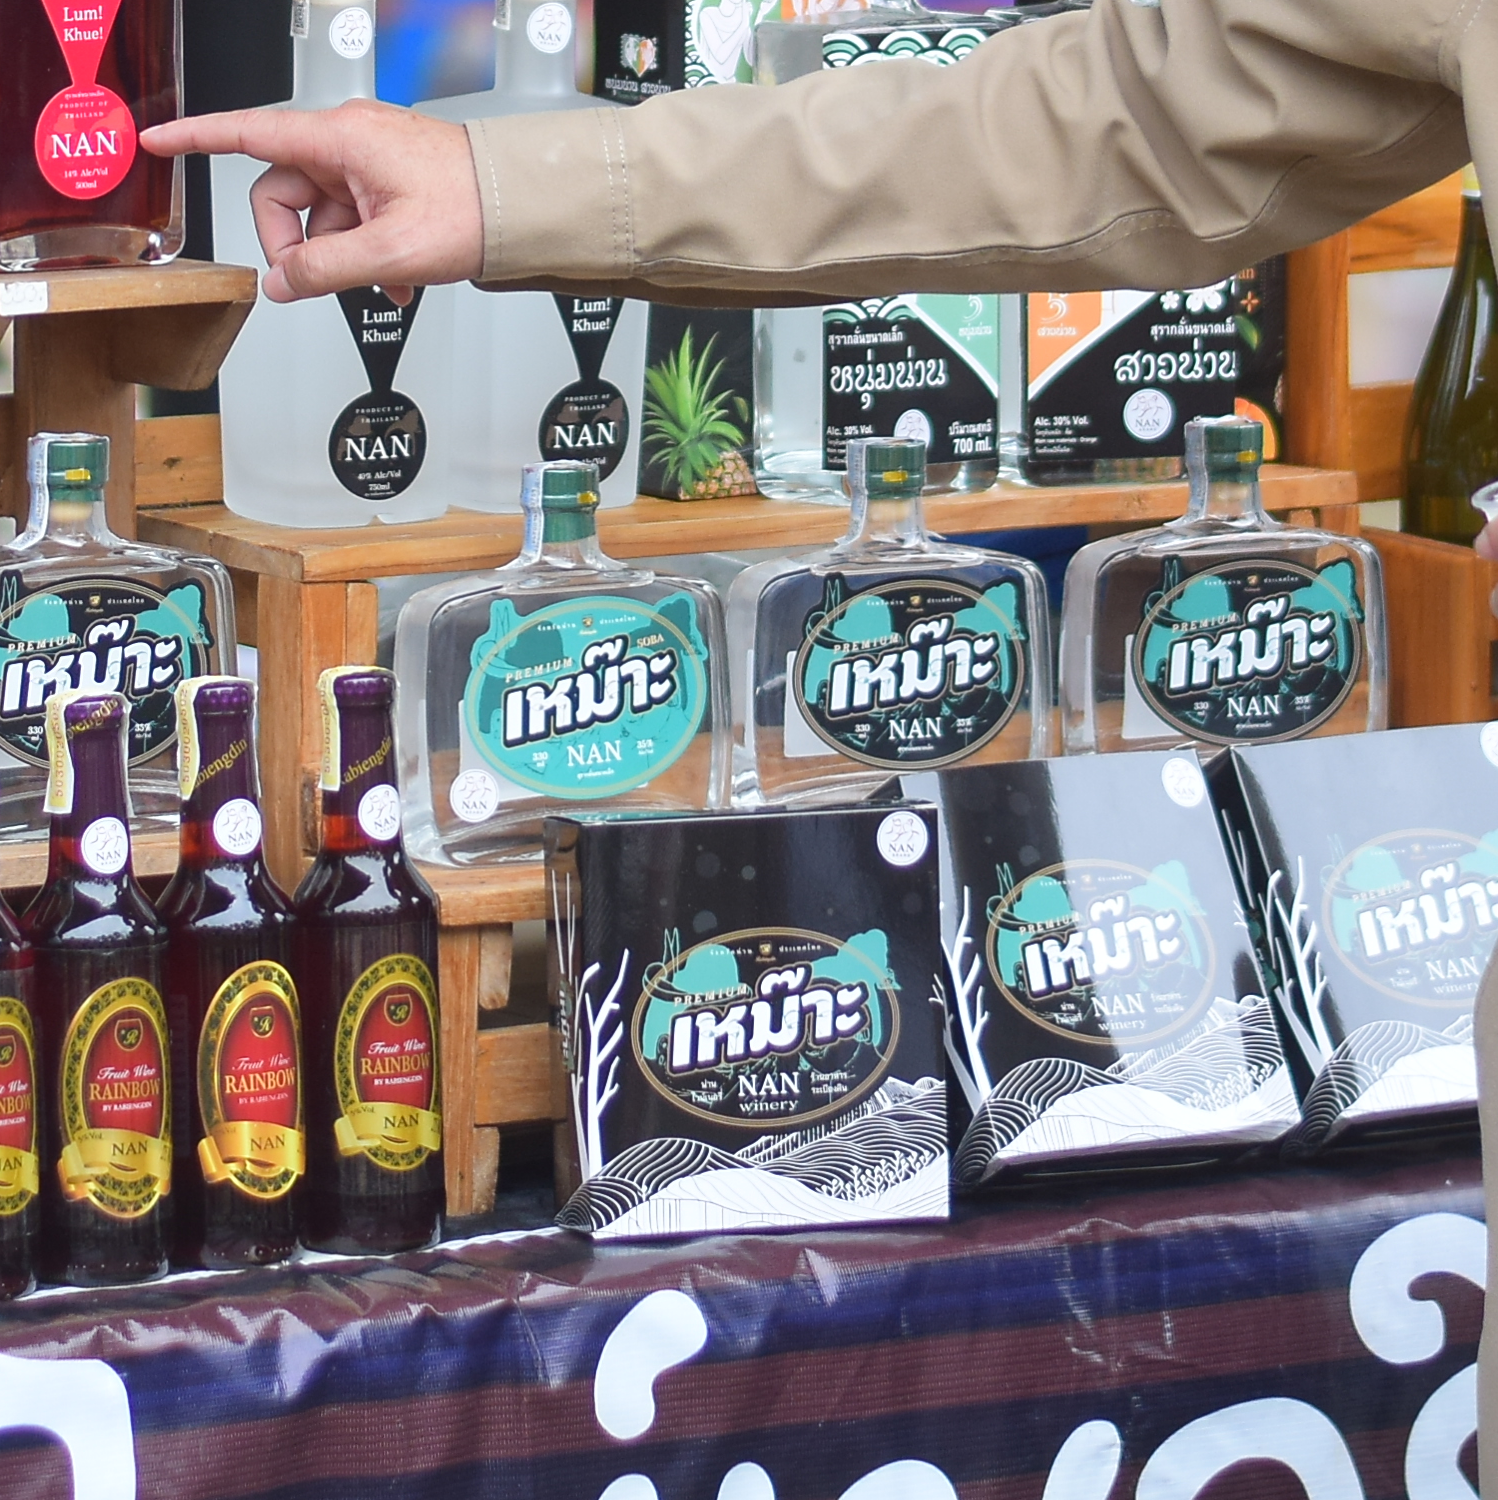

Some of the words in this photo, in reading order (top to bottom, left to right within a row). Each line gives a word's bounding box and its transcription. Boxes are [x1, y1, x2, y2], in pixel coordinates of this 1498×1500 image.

[63, 7, 103, 21] Lum!
[63, 27, 103, 41] Khue!
[537, 32, 561, 42] NAN
[340, 38, 364, 48] NAN
[51, 131, 117, 158] NAN
[573, 297, 611, 313] Lum!
[362, 307, 402, 324] Lum!
[573, 318, 611, 332] Khue!
[362, 328, 402, 343] Khue!
[830, 346, 946, 409] หนุ่มน่าน
[1034, 417, 1051, 426] Alc.
[1053, 416, 1070, 426] 30%
[1073, 417, 1089, 425] Vol.
[1135, 418, 1160, 427] NAN
[553, 422, 615, 449] NAN
[827, 427, 842, 435] Alc.
[844, 426, 859, 435] 30%
[345, 433, 411, 461] NAN
[953, 438, 973, 454] 700
[976, 437, 992, 452] ml.
[1171, 613, 1237, 633] PREMIUM
[8, 634, 77, 653] PREMIUM
[636, 633, 664, 648] SOBA
[833, 634, 900, 654] PREMIUM
[505, 657, 573, 683] PREMIUM
[1227, 695, 1279, 717] NAN
[28, 726, 43, 734] 330
[855, 724, 870, 732] 330
[889, 718, 941, 740] NAN
[532, 751, 548, 761] 330
[567, 740, 622, 766] NAN
[461, 801, 487, 810] NAN
[374, 814, 397, 828] NAN
[228, 831, 253, 843] NAN
[96, 850, 121, 861] NAN
[889, 843, 915, 854] NAN
[1426, 957, 1478, 981] NAN
[674, 984, 749, 1007] PREMIUM
[1093, 993, 1142, 1017] NAN
[1098, 1017, 1147, 1032] winery
[368, 1041, 400, 1055] Fruit
[403, 1039, 426, 1052] Wine
[232, 1057, 263, 1071] Fruit
[268, 1053, 290, 1068] Wine
[361, 1051, 431, 1075] RAINBOW
[97, 1067, 130, 1080] Fruit
[133, 1065, 156, 1078] Wine
[8, 1080, 28, 1093] Wine
[225, 1068, 296, 1094] RAINBOW
[738, 1072, 799, 1097] NAN
[90, 1078, 161, 1101] RAINBOW
[740, 1099, 798, 1115] winery
[384, 1114, 419, 1129] NAN
[112, 1141, 148, 1157] NAN
[251, 1134, 285, 1152] NAN
